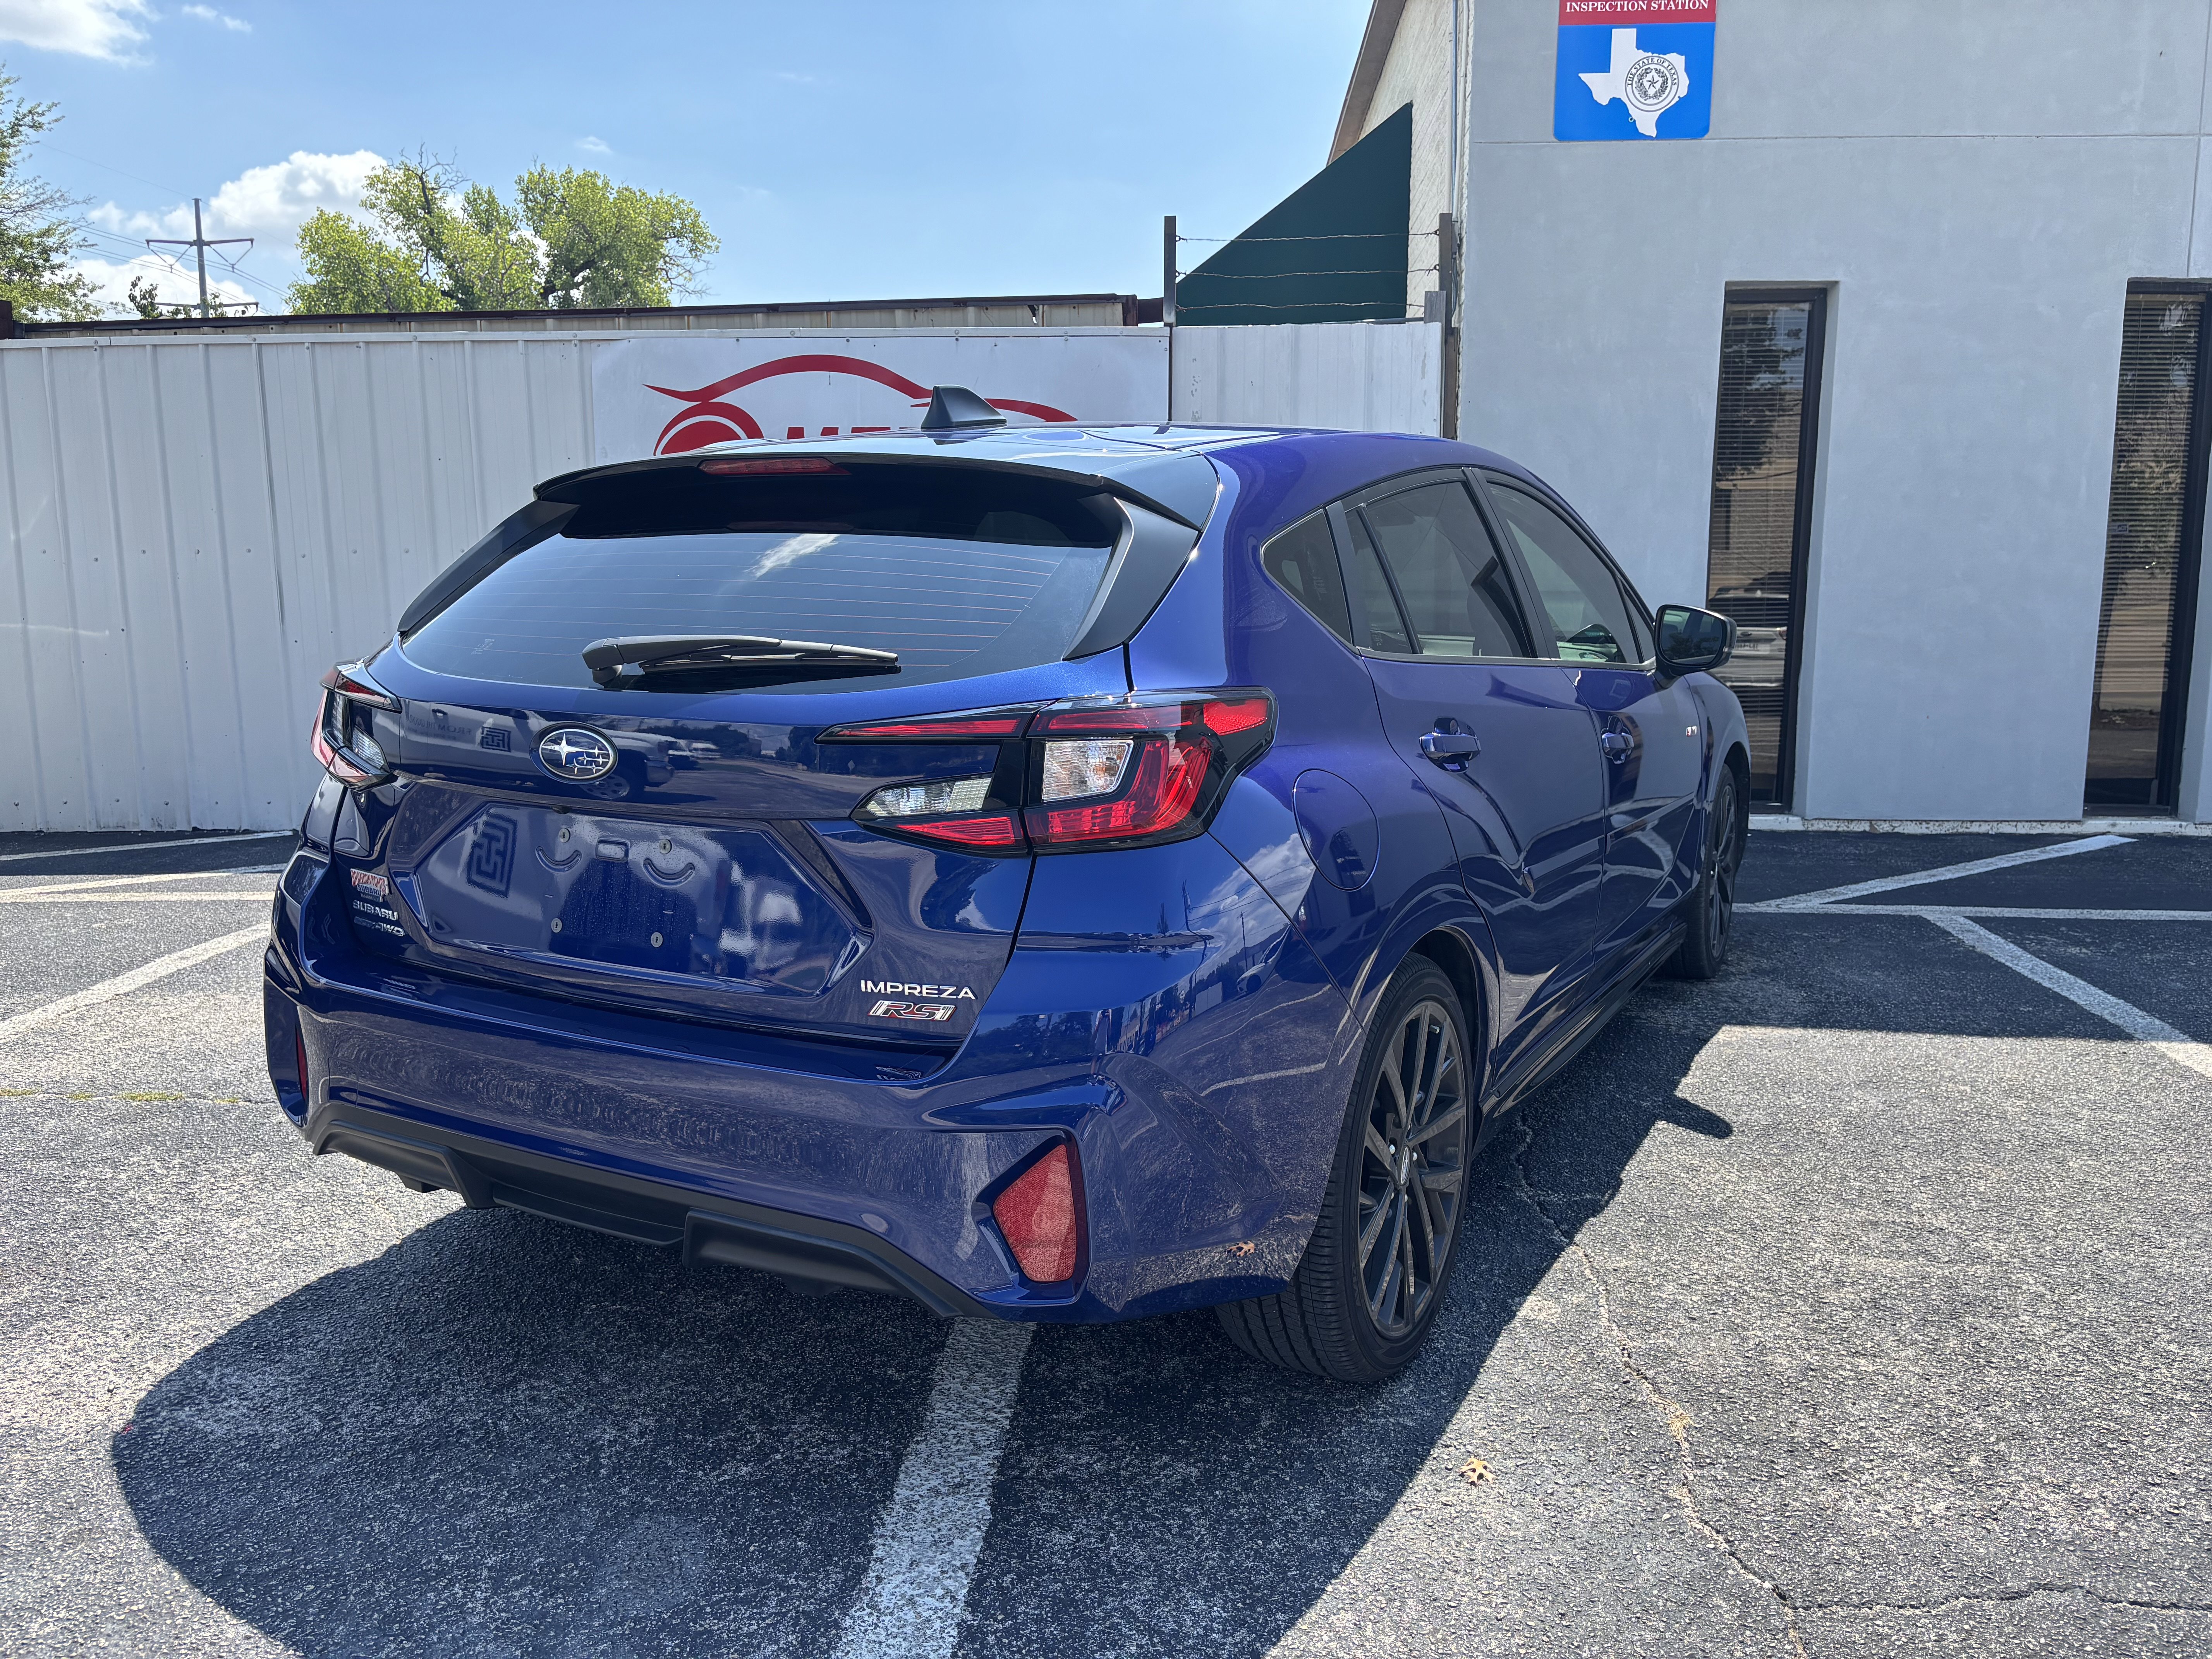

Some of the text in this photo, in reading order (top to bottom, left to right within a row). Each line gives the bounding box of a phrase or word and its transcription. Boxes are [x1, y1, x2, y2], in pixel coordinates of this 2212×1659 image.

[1566, 0, 1709, 12] INSPECTION STATION
[1634, 58, 1655, 70] STATE
[1666, 64, 1677, 86] TEXAS
[353, 900, 398, 921] SUBARU
[372, 922, 405, 937] AWD
[860, 980, 977, 1000] IMPREZA
